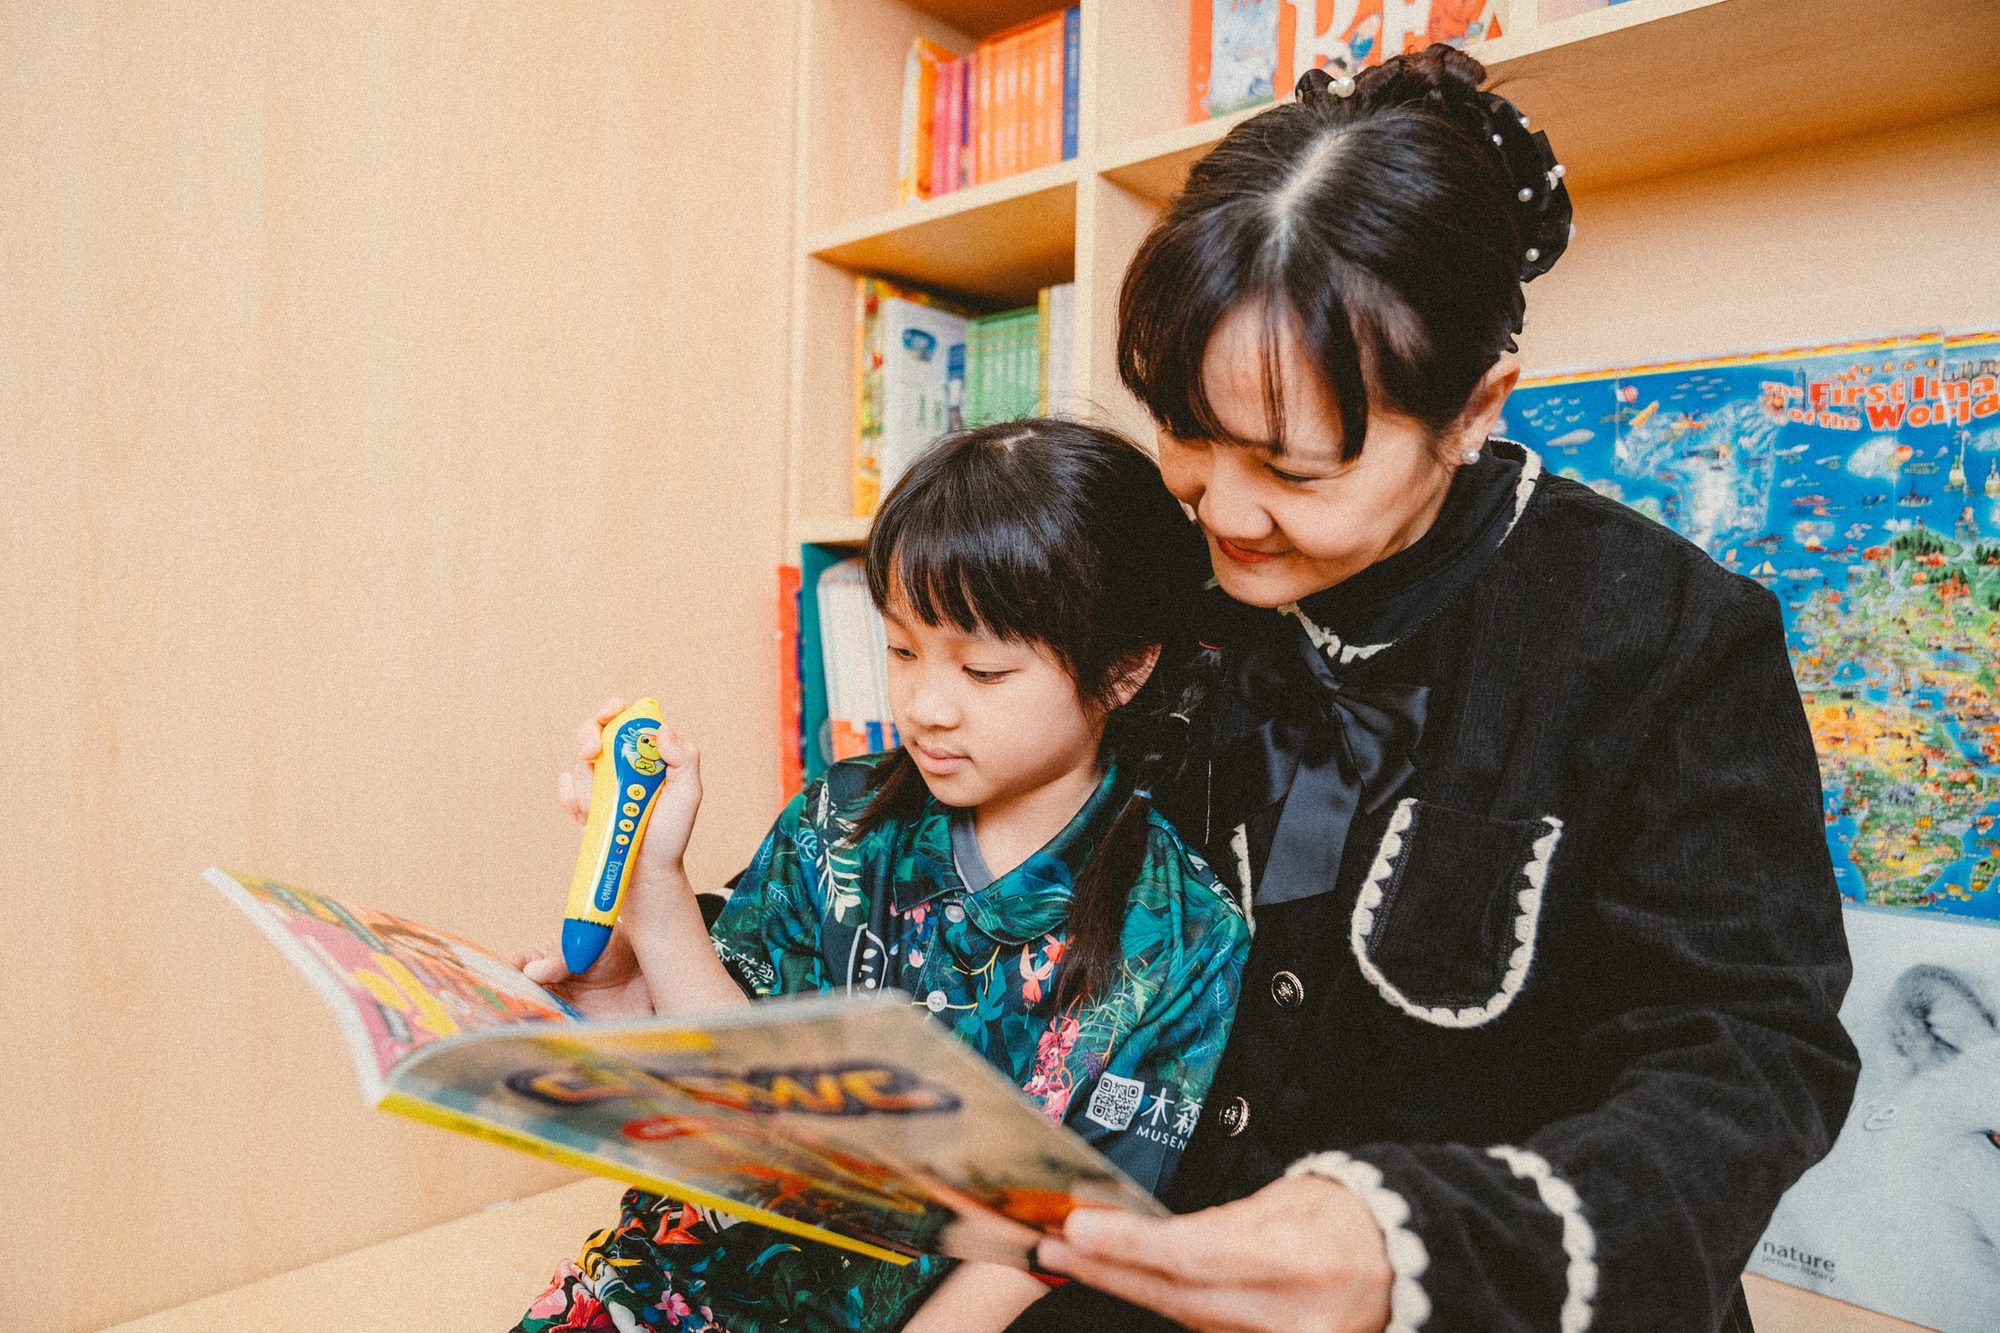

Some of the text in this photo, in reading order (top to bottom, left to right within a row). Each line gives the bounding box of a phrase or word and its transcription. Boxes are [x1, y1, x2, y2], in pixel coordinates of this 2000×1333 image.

[1809, 379, 1905, 405] First
[1866, 393, 2000, 431] World
[1136, 1125, 1188, 1151] MUSEN
[1763, 1241, 1835, 1273] nature
